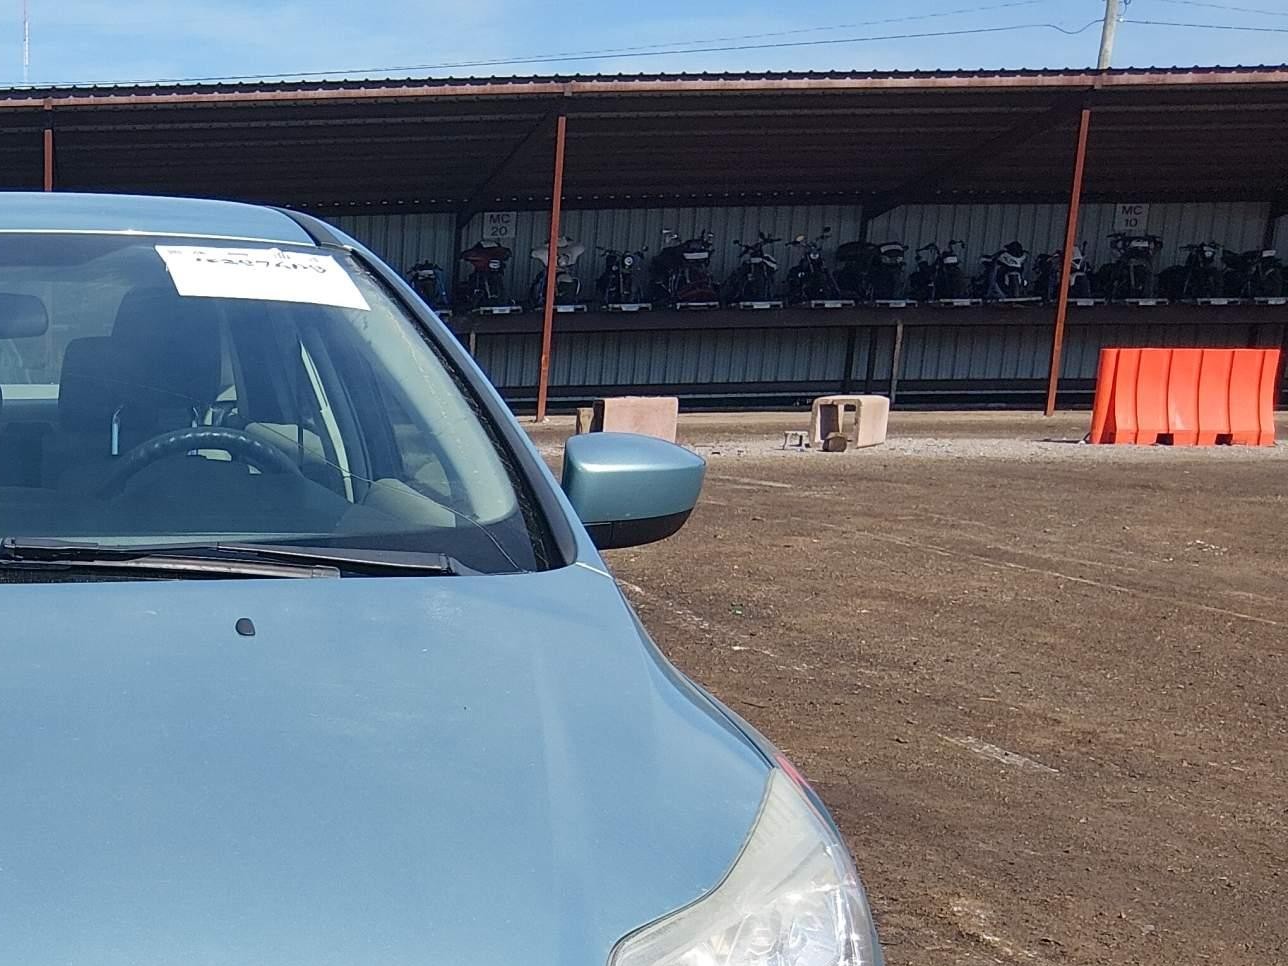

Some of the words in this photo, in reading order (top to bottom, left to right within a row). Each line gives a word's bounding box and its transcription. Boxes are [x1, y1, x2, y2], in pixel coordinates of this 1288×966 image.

[1121, 205, 1144, 216] MC
[489, 213, 511, 224] MC
[1124, 218, 1138, 228] 10
[491, 225, 508, 237] 20
